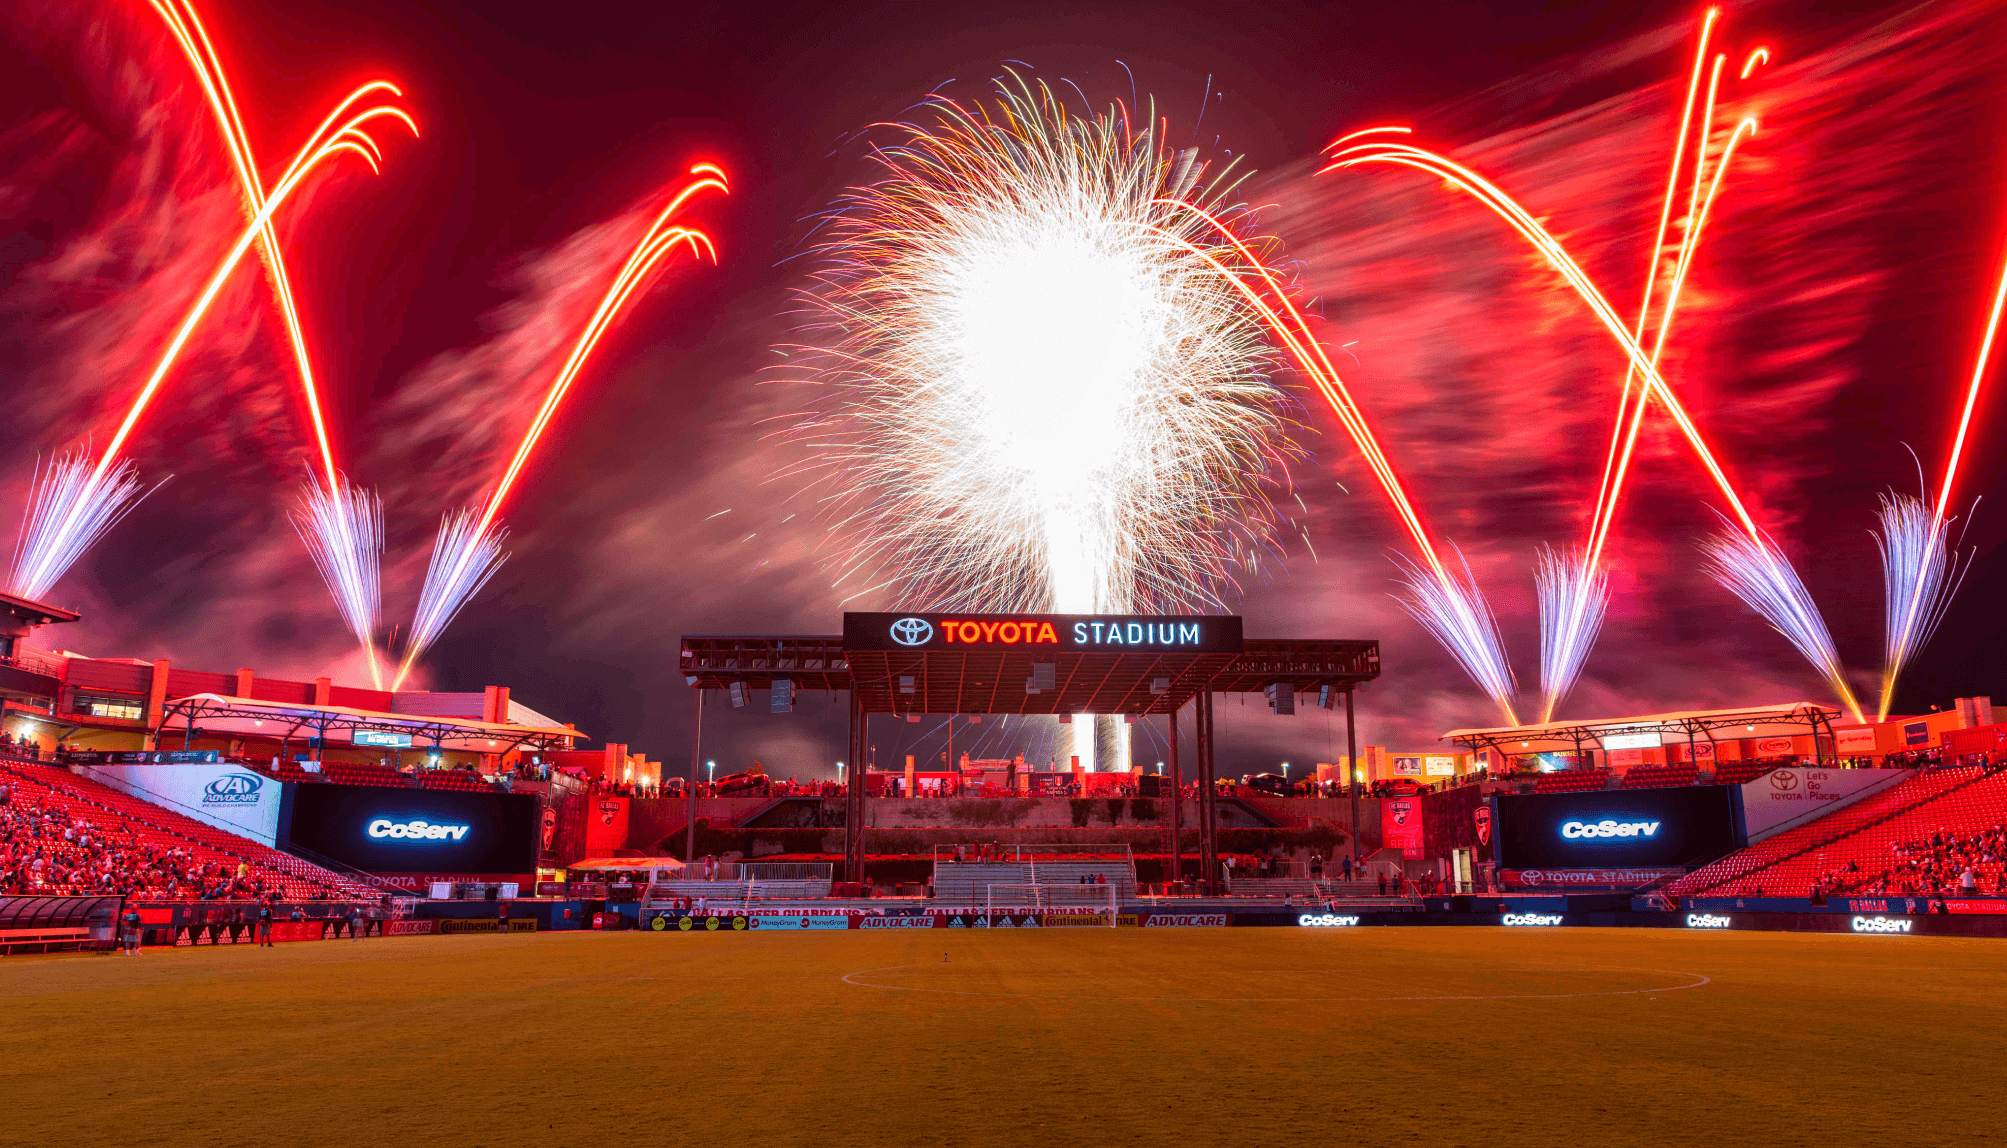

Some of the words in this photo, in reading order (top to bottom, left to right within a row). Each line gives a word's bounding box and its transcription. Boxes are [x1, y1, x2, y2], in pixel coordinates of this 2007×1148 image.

[942, 620, 1058, 644] TOYOTA
[1073, 623, 1199, 645] STADIUM
[1807, 772, 1828, 780] Let's
[1807, 781, 1821, 790] Go
[202, 793, 261, 802] ADVOCARE
[1809, 792, 1840, 800] Places
[368, 819, 469, 840] CoServ
[1562, 820, 1660, 839] CoServ
[1391, 840, 1416, 849] BEER
[363, 877, 417, 887] TOYOTA
[1546, 872, 1595, 882] TOYOTA
[1602, 872, 1660, 882] STADIUM
[811, 919, 847, 927] MoneyGram
[859, 916, 934, 929] ADVOCARE
[1045, 916, 1102, 927] Continental
[1145, 914, 1226, 927] ADVOCARE
[1299, 914, 1359, 926] CoServ
[1503, 914, 1562, 925] CoServ
[1687, 914, 1731, 927] CoServ
[1852, 916, 1912, 931] CoServ
[389, 921, 433, 935] ADVOCARE
[441, 920, 498, 934] Continenta
[512, 921, 534, 930] TIRE
